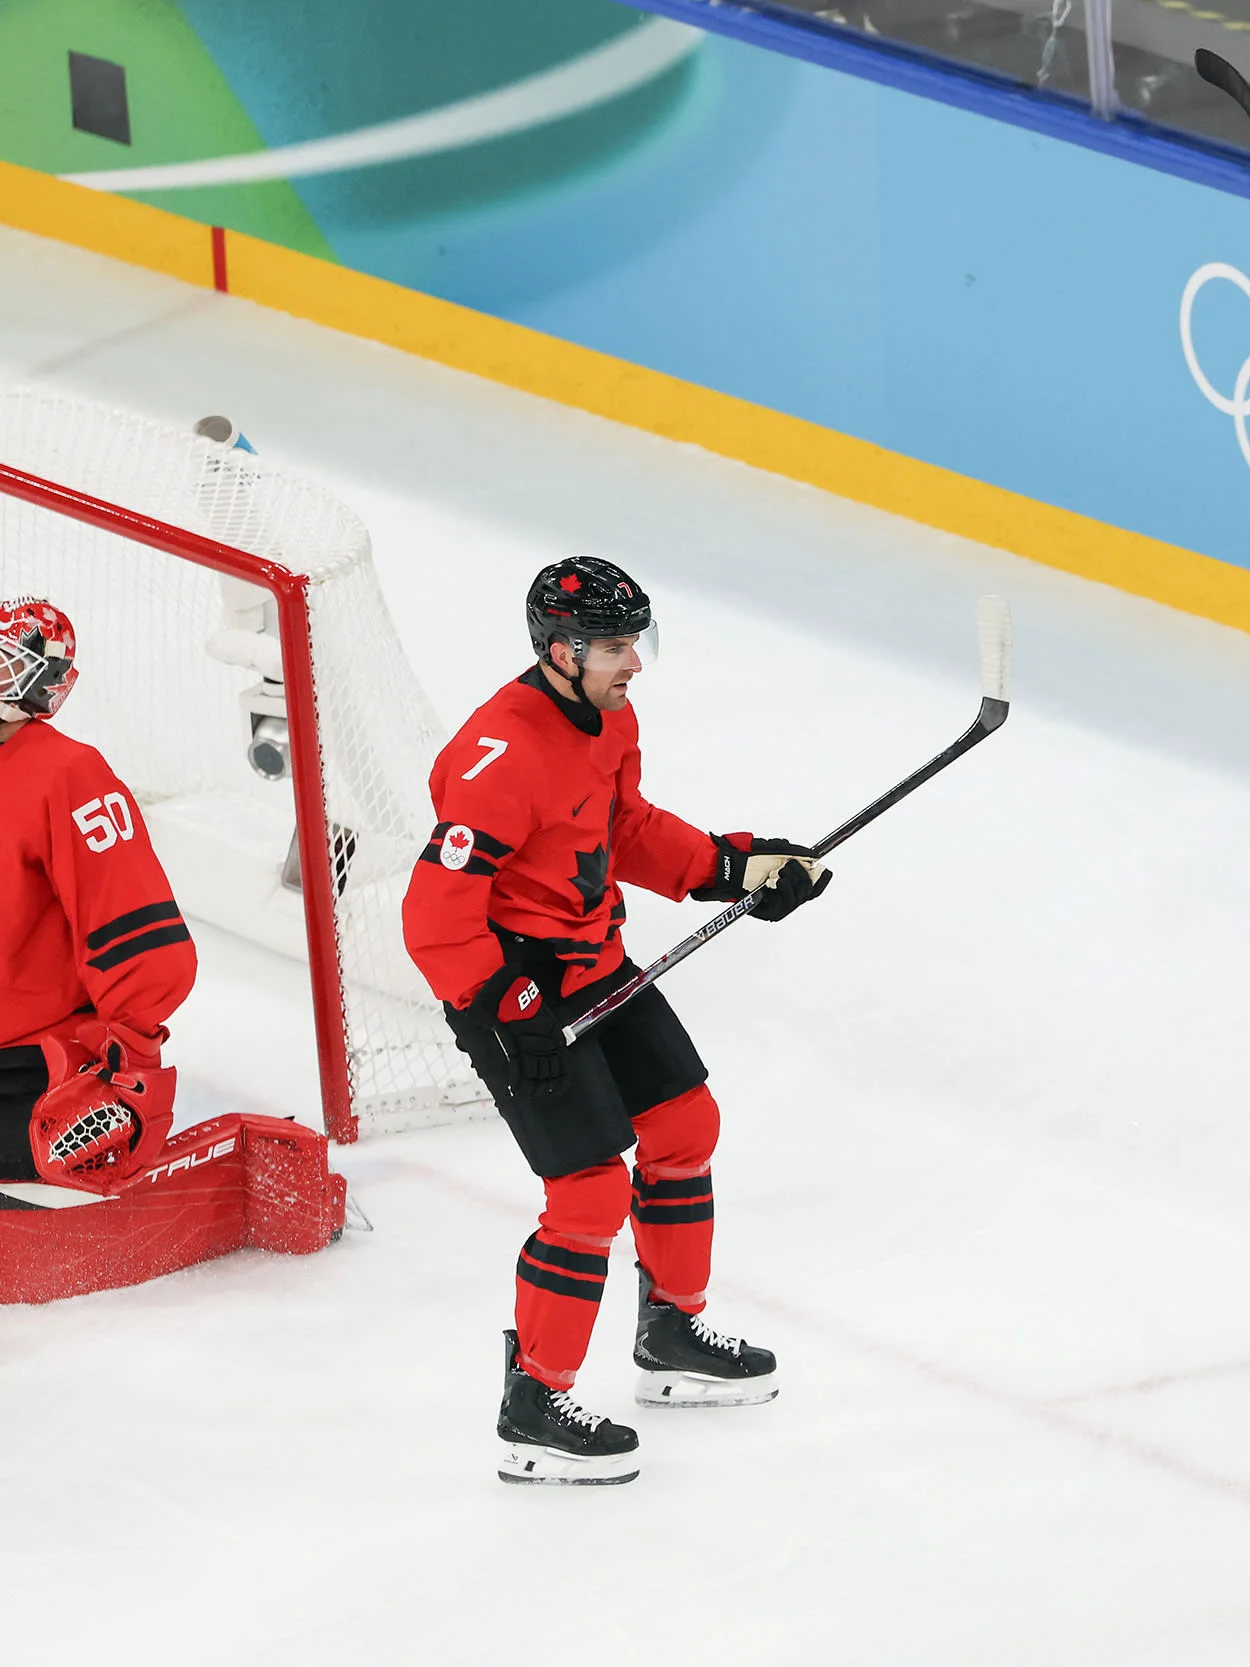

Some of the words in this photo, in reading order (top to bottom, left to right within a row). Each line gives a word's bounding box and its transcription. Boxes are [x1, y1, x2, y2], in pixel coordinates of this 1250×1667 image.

[617, 582, 633, 598] 7
[461, 736, 510, 780] 7
[71, 791, 134, 853] 50
[723, 855, 731, 881] MACH
[145, 1137, 236, 1183] TRUE
